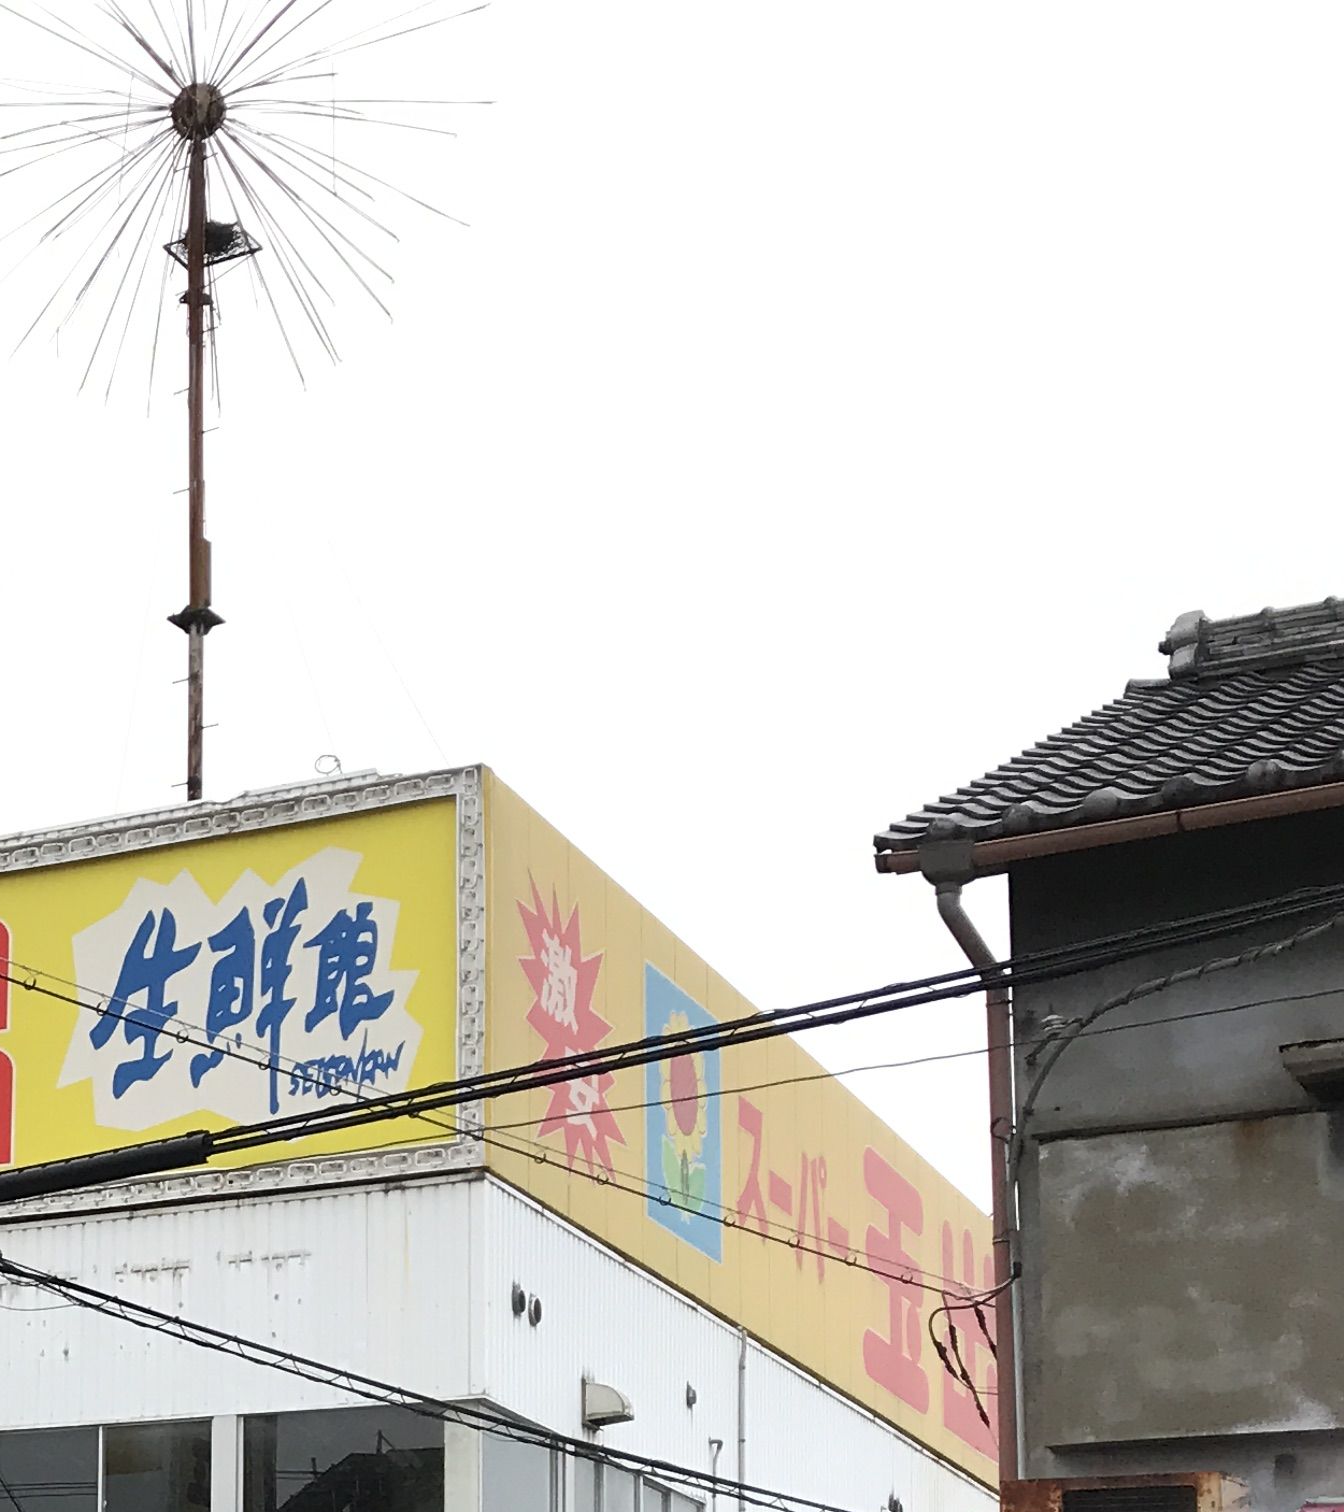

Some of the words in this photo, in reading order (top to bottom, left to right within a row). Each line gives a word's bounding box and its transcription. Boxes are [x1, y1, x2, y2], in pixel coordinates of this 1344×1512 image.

[90, 877, 394, 1114] 生鮮館
[735, 1095, 851, 1284] スーパー
[862, 1145, 999, 1463] 玉出
